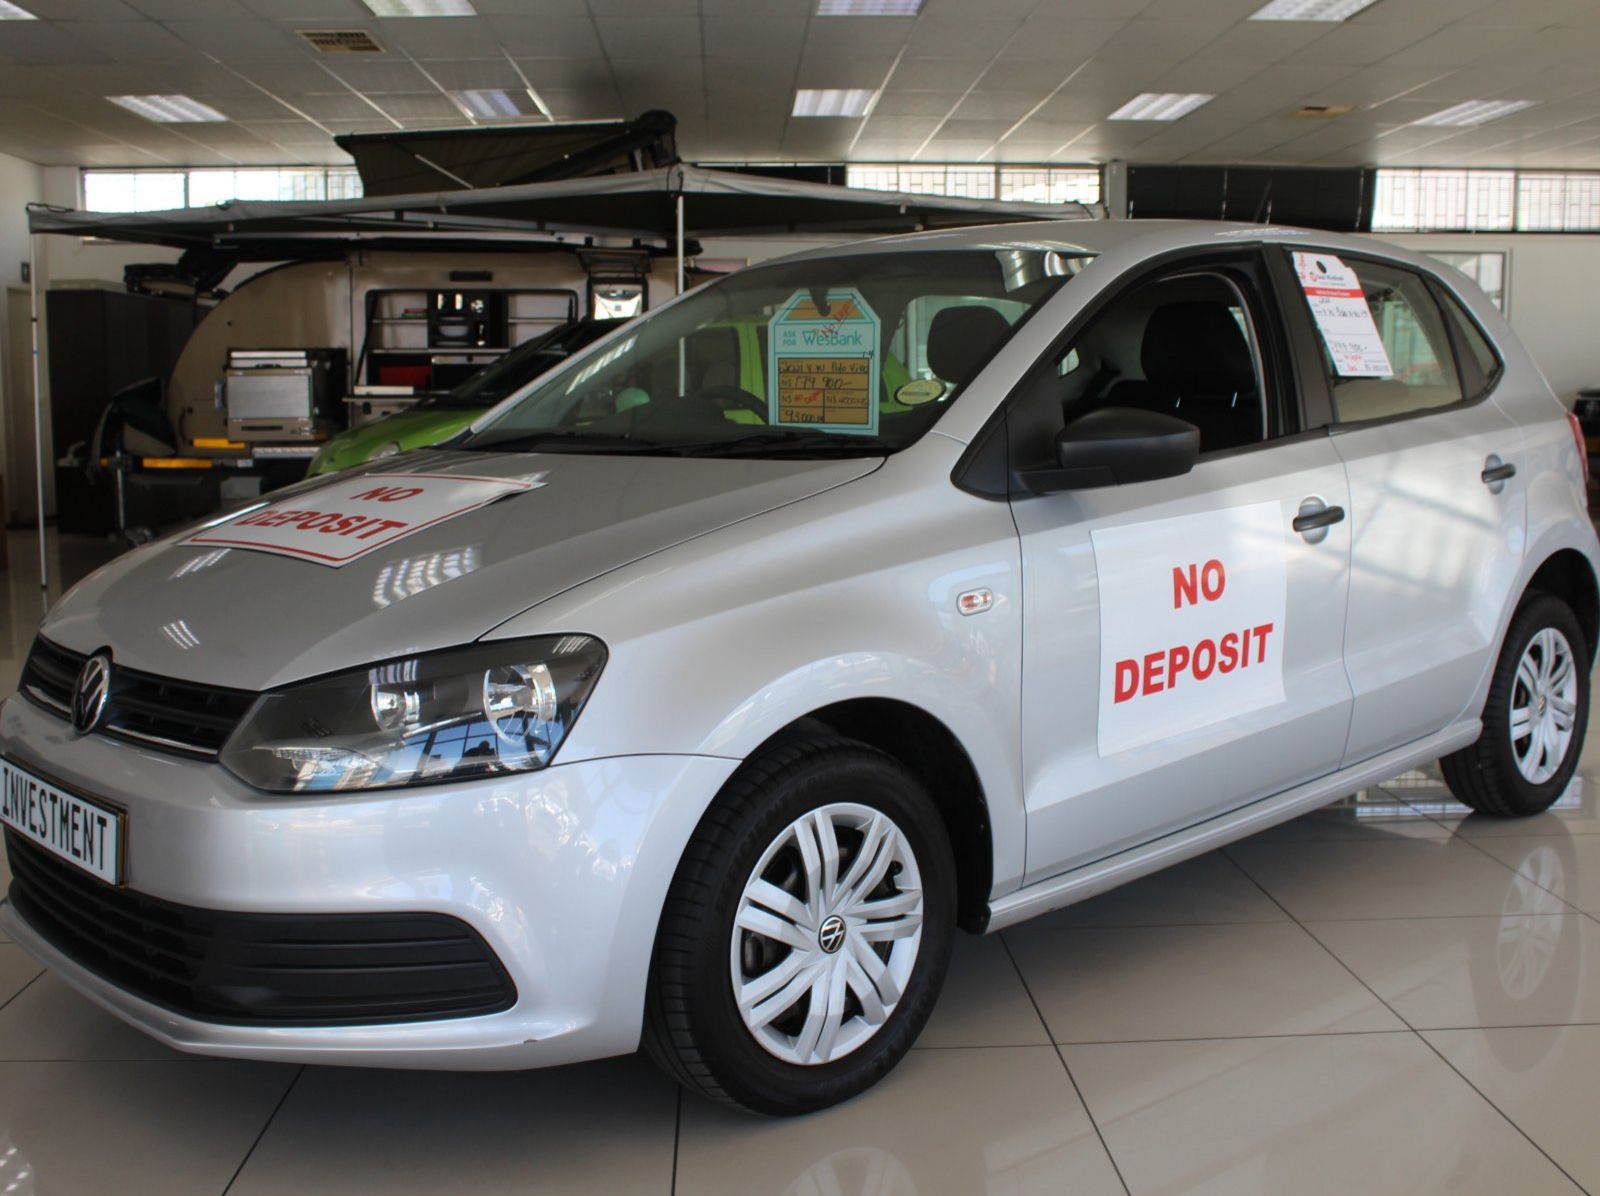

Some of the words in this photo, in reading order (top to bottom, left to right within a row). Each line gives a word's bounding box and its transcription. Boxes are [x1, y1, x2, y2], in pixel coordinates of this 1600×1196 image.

[802, 329, 863, 346] WesBank
[349, 486, 425, 503] NO
[234, 510, 409, 540] DEPOSIT
[1172, 558, 1226, 610] NO
[1113, 622, 1274, 705] DEPOSIT
[2, 766, 107, 872] INVESTMENT
